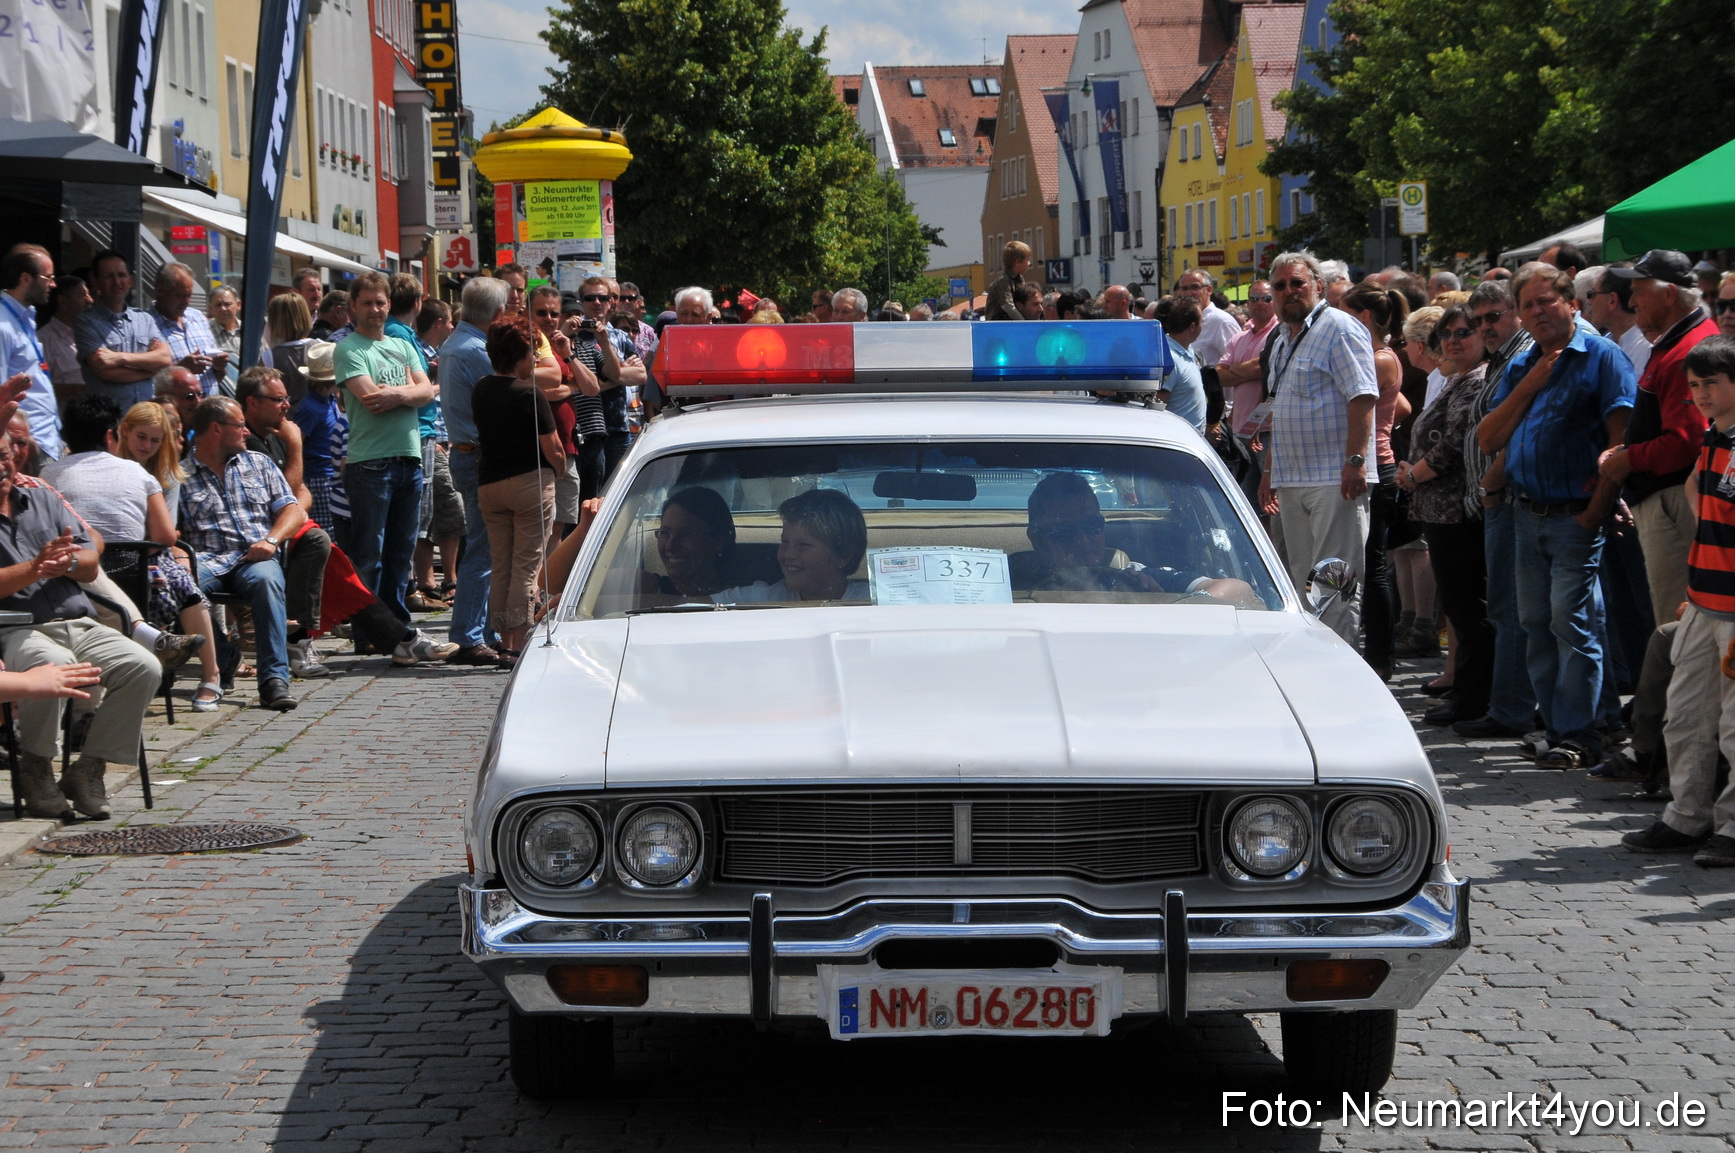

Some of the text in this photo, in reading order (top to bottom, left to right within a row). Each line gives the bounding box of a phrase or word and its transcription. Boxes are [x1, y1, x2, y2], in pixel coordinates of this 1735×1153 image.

[421, 2, 457, 186] HOTEL
[1111, 136, 1125, 190] RUPPERT
[532, 185, 593, 195] 3. Neumarkter
[530, 195, 596, 204] Oldtimertreffen
[434, 204, 457, 213] Stern
[938, 559, 991, 579] 337
[870, 986, 1096, 1028] NM 06280
[841, 1015, 850, 1027] D
